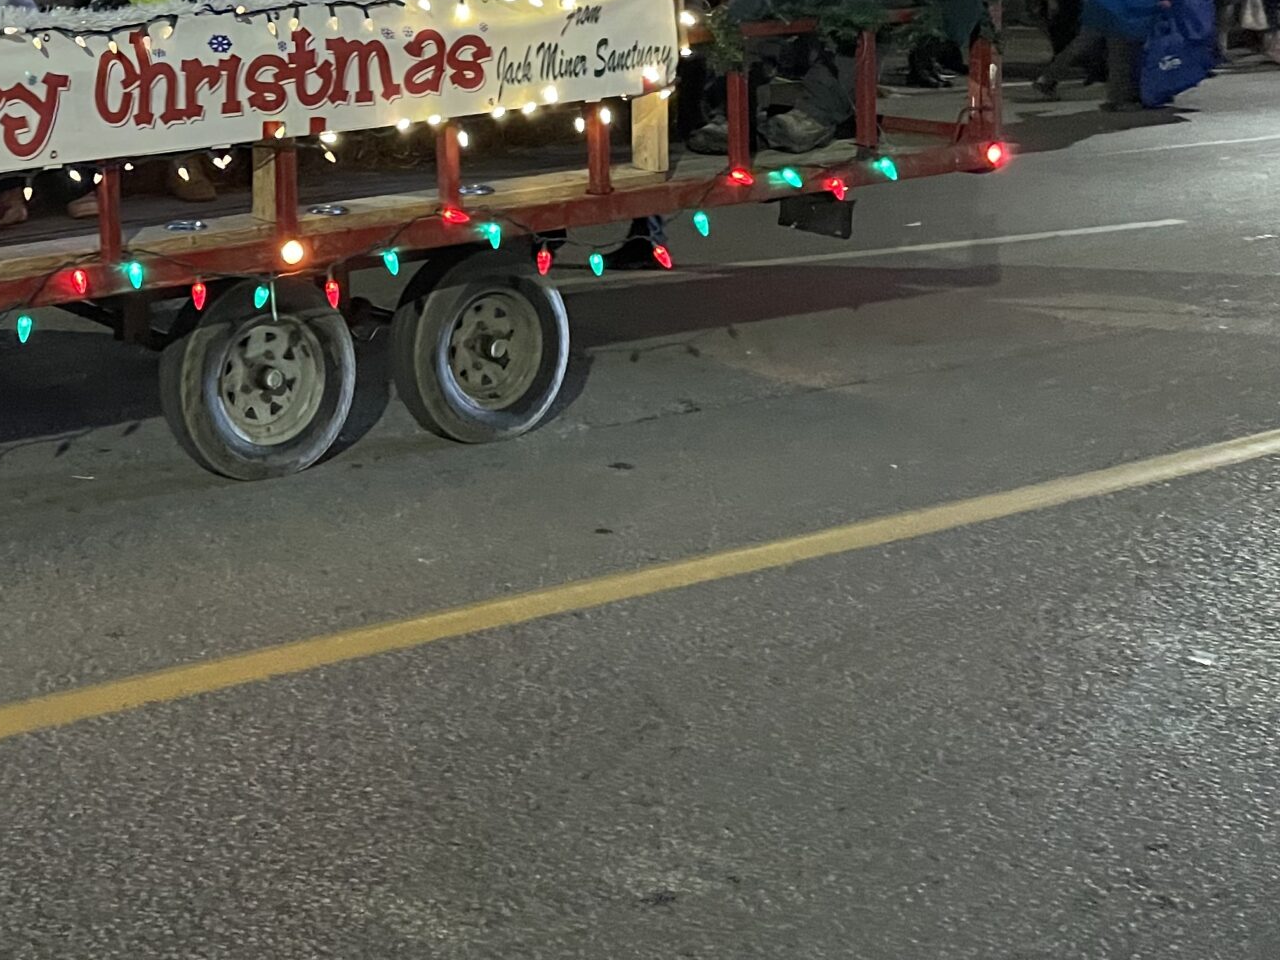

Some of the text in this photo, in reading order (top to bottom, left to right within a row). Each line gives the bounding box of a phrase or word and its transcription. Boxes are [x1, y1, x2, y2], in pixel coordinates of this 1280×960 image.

[94, 26, 493, 129] Christmas
[496, 38, 674, 103] Jack Miner Sanctuary
